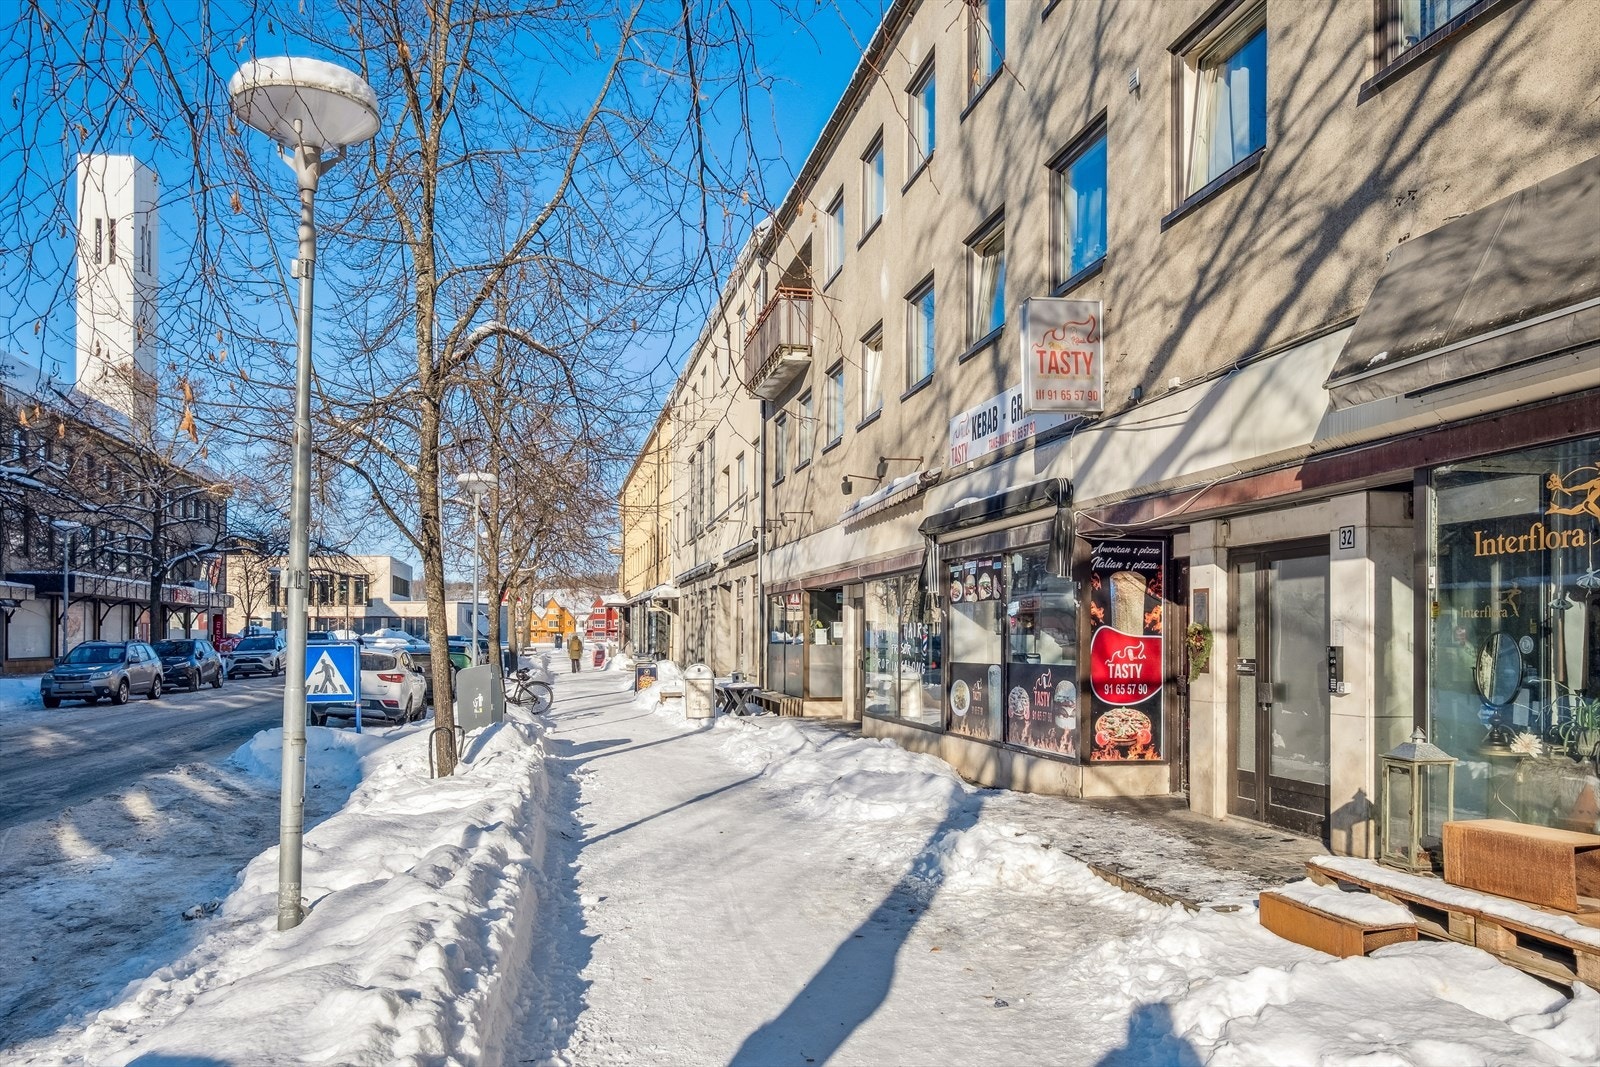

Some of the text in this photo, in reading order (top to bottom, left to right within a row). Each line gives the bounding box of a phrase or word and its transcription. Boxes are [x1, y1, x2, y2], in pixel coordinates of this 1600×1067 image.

[1036, 350, 1094, 375] TASTY
[1048, 389, 1057, 400] 91
[1061, 389, 1071, 400] 65
[1074, 390, 1084, 401] 57
[1087, 390, 1098, 401] 90
[971, 405, 998, 441] KEBAB
[951, 442, 968, 465] TASTY
[1341, 529, 1352, 545] 32
[1474, 522, 1587, 557] Interflora
[1091, 542, 1131, 554] American
[1138, 546, 1160, 556] pizza
[1091, 556, 1123, 571] Italian
[1131, 560, 1159, 571] pizza
[1461, 605, 1508, 618] Interflora
[904, 622, 922, 640] HAIR
[1108, 664, 1142, 678] TASTY
[1104, 684, 1148, 694] 91 65 57 90
[1034, 691, 1050, 707] TASTY
